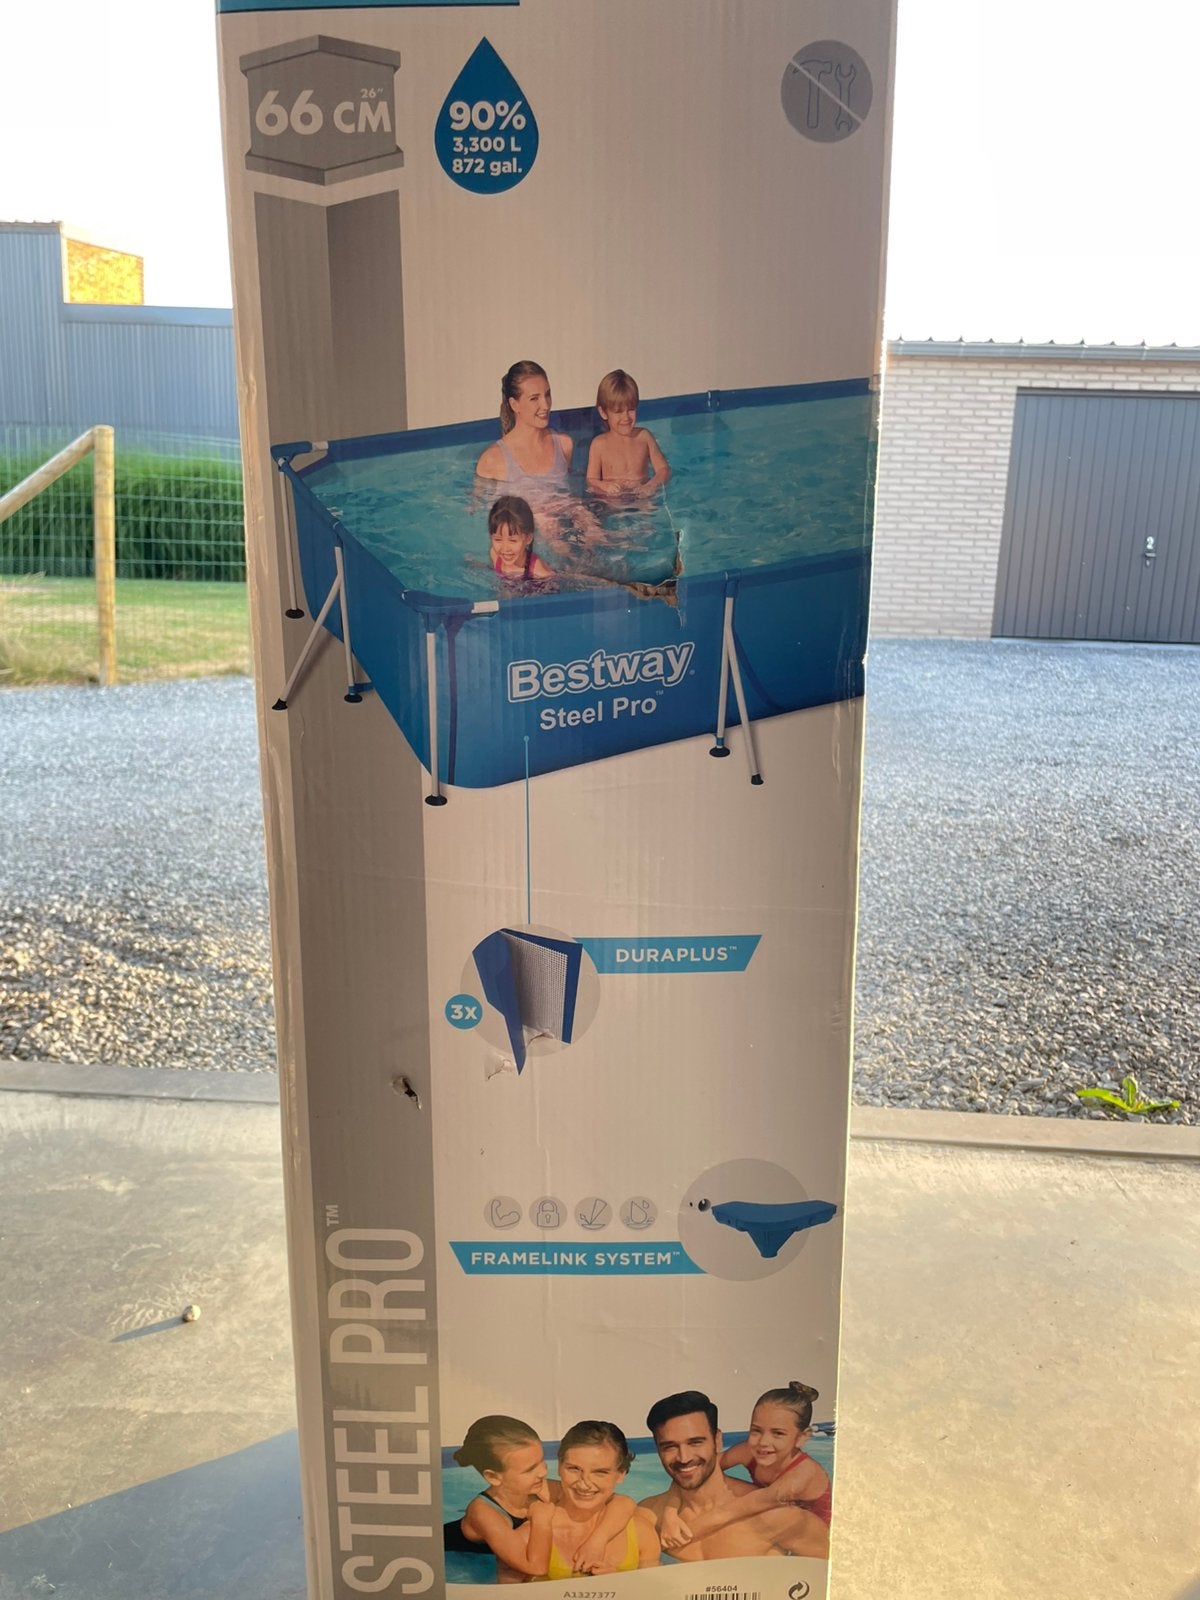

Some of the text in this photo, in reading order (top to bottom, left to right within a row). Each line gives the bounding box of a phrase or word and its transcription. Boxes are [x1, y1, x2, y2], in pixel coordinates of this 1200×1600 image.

[255, 89, 392, 137] 66 CM
[449, 100, 527, 132] 90%
[452, 136, 521, 155] 3,300 L
[452, 158, 522, 176] 872 gal.
[507, 641, 695, 703] Bestway
[539, 701, 603, 731] Steel
[612, 696, 657, 720] Pro
[471, 1252, 587, 1266] FRAMELINK
[595, 1251, 671, 1266] SYSTEM
[325, 1228, 428, 1366] PRO
[332, 1385, 435, 1595] STEEL
[563, 1591, 616, 1599] A1327377
[706, 1584, 738, 1593] #56404
